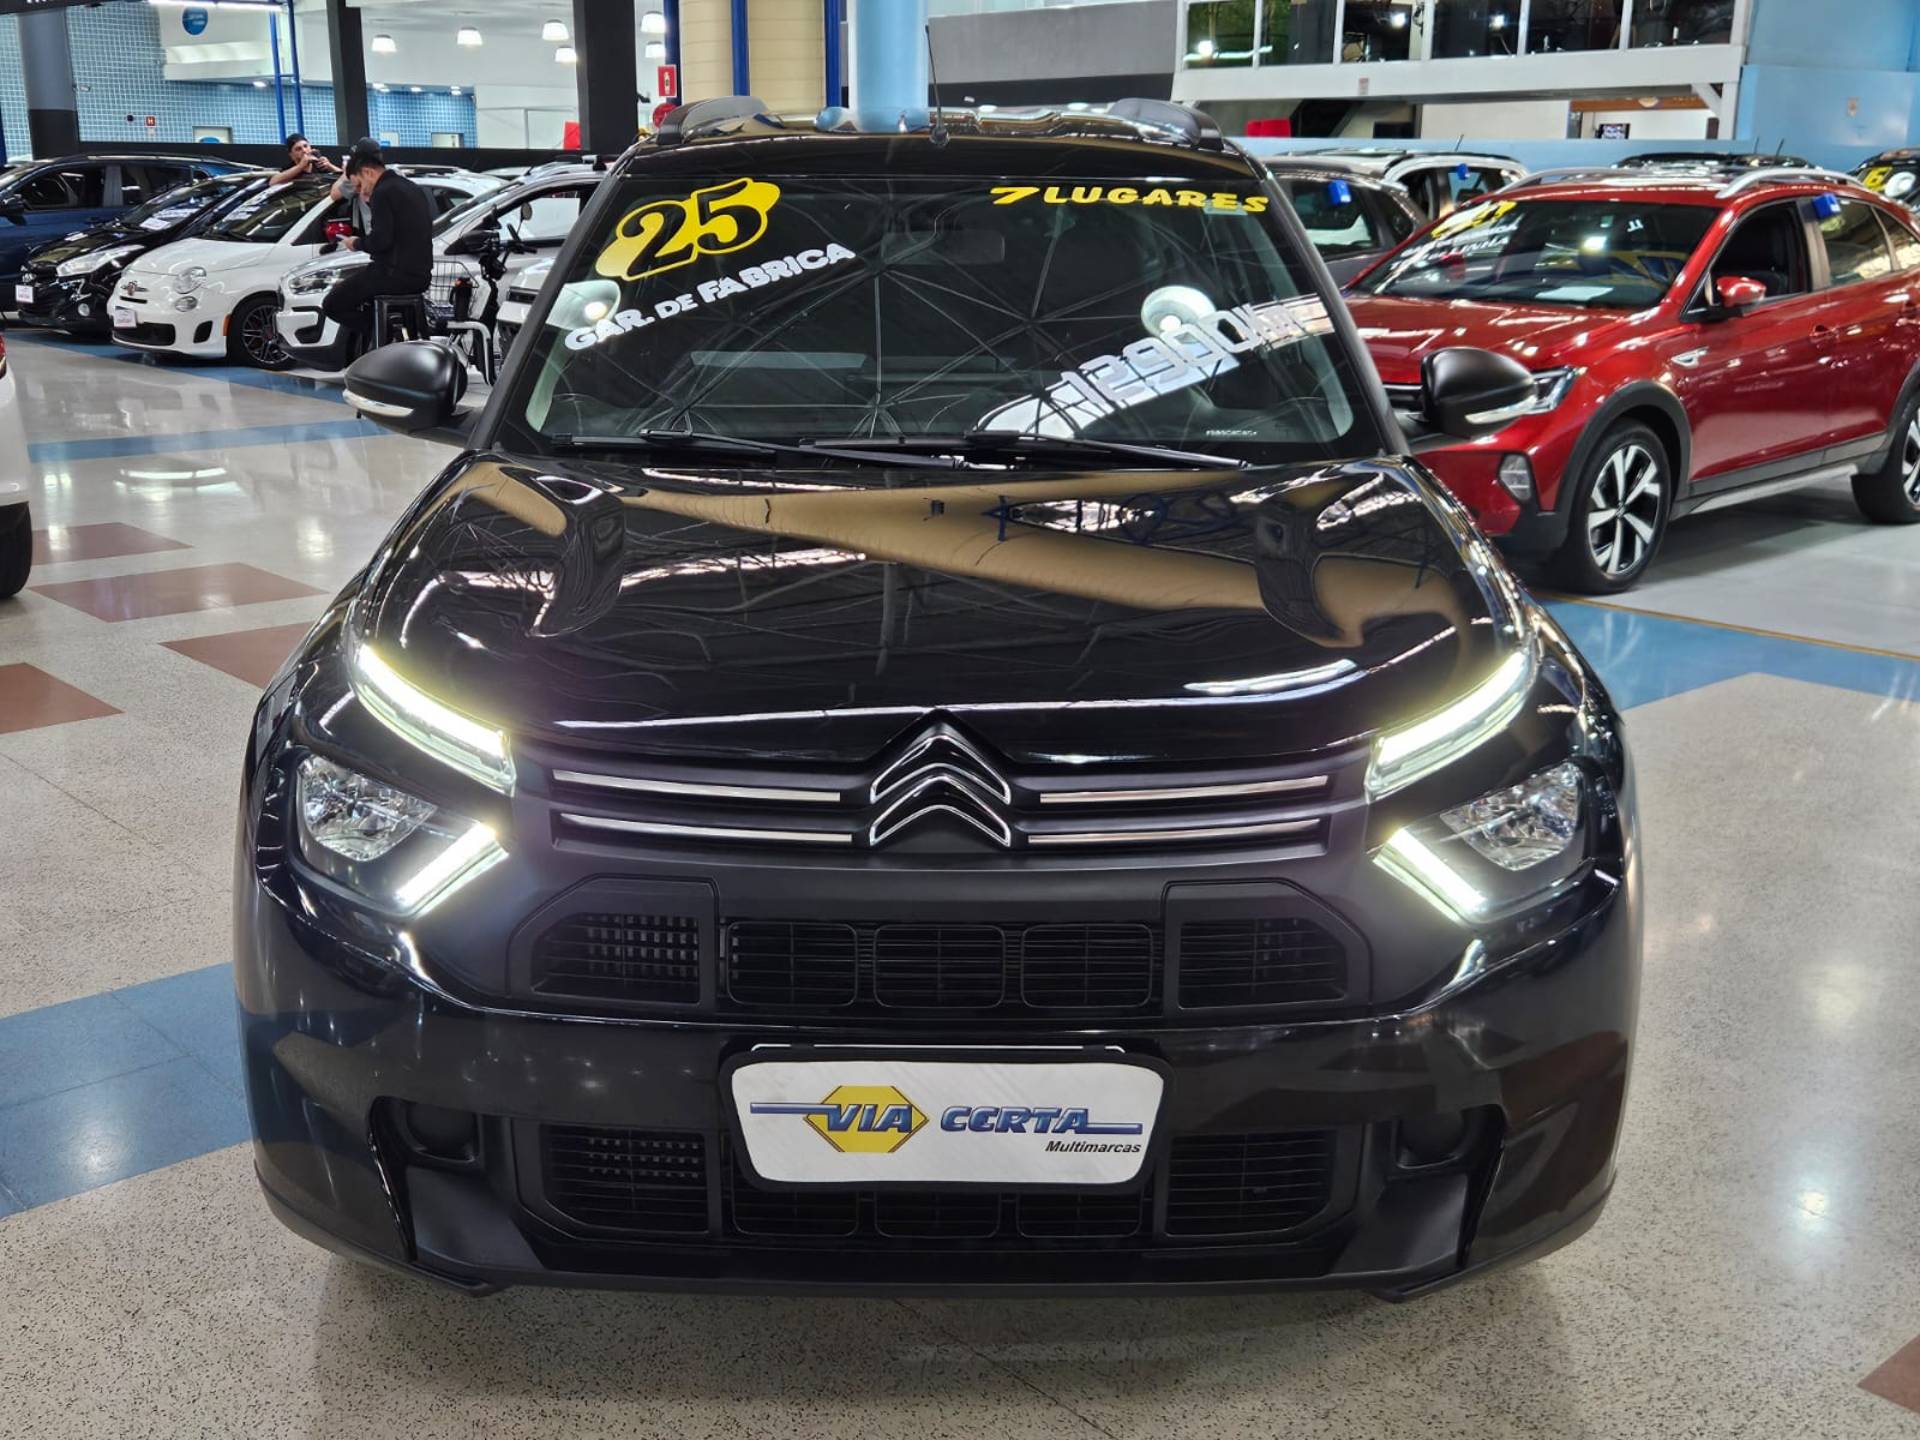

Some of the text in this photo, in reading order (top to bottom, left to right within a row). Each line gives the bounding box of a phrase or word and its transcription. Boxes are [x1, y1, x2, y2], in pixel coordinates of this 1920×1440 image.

[989, 187, 1268, 213] 7 LUGARES
[604, 178, 776, 280] 25
[654, 293, 699, 319] DE
[825, 1103, 913, 1135] VIA
[1045, 1140, 1142, 1153] Multimarcas
